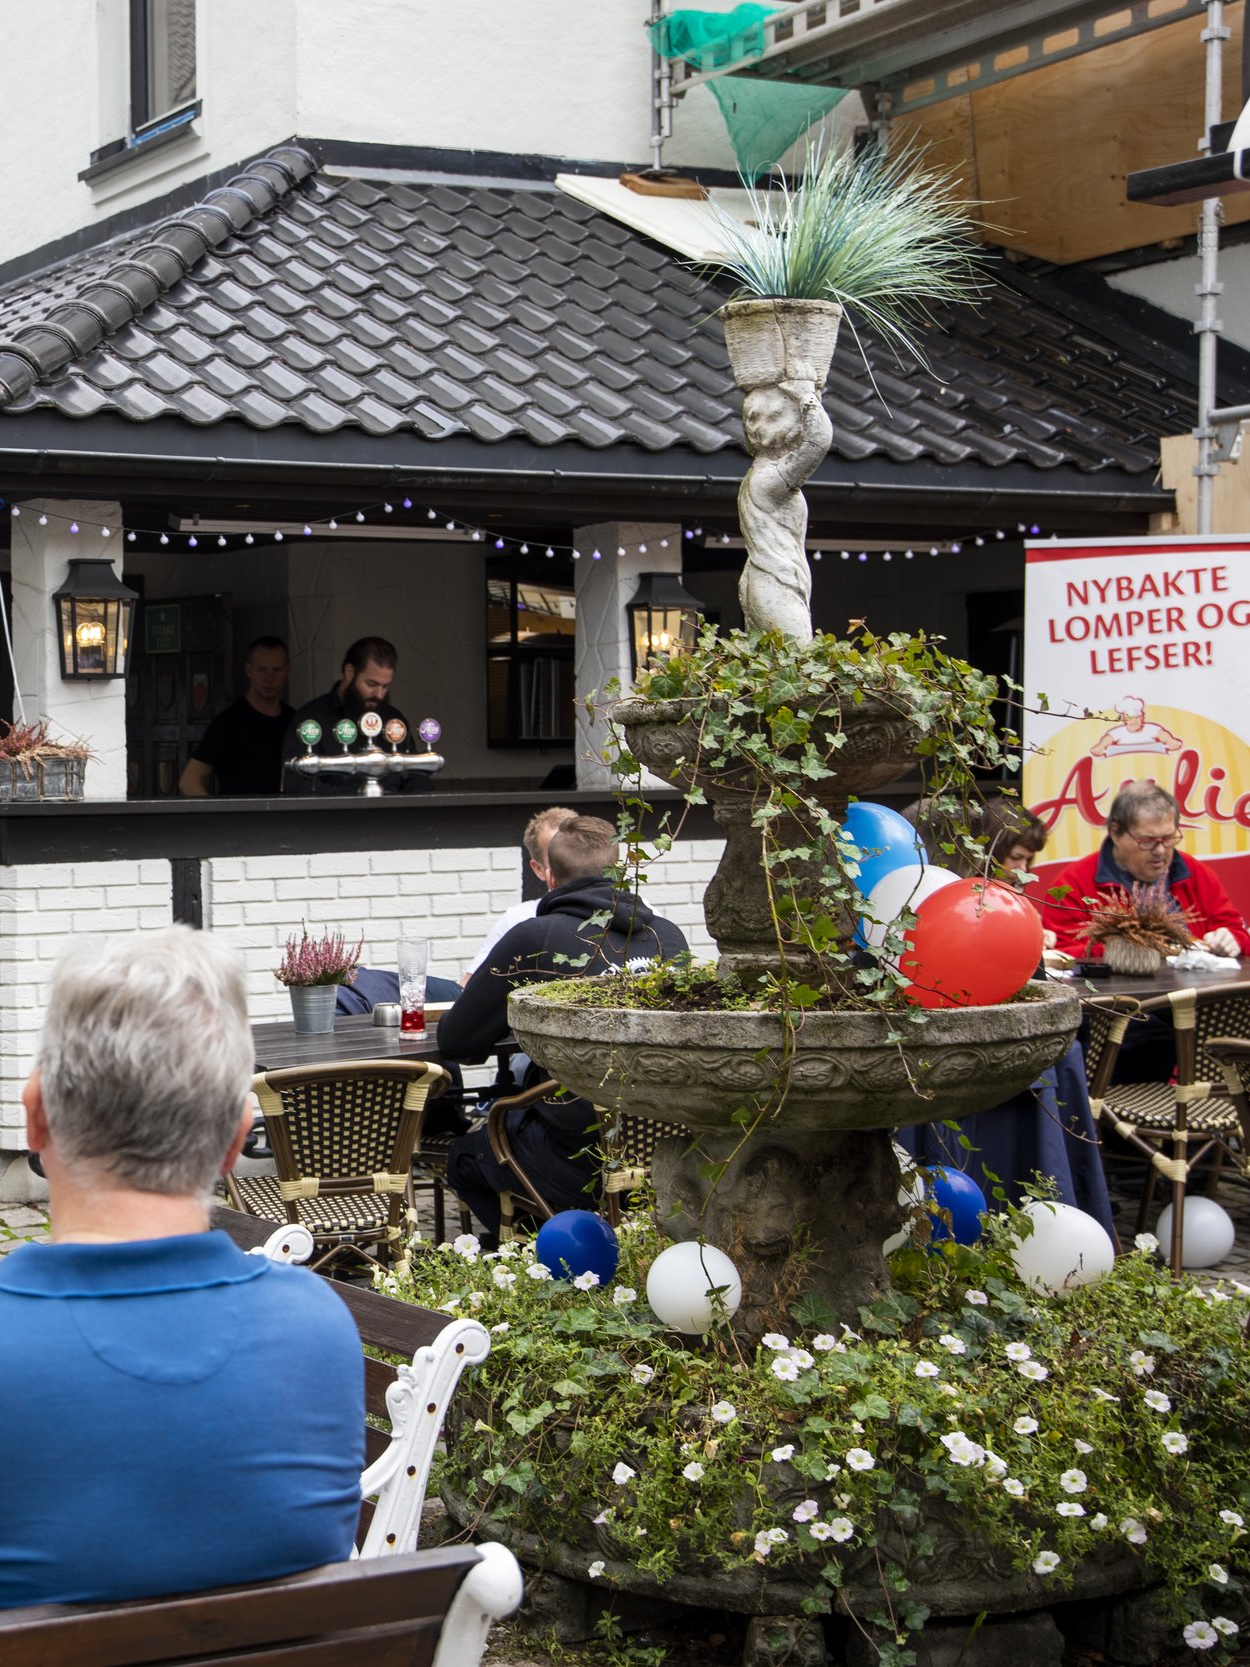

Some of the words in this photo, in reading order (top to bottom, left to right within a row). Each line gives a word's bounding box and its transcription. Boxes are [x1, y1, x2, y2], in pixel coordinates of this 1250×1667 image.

[1066, 565, 1229, 607] NYBAKTE
[1048, 606, 1187, 644] LOMPER
[1197, 599, 1250, 630] OG
[1090, 640, 1214, 675] LEFSER!
